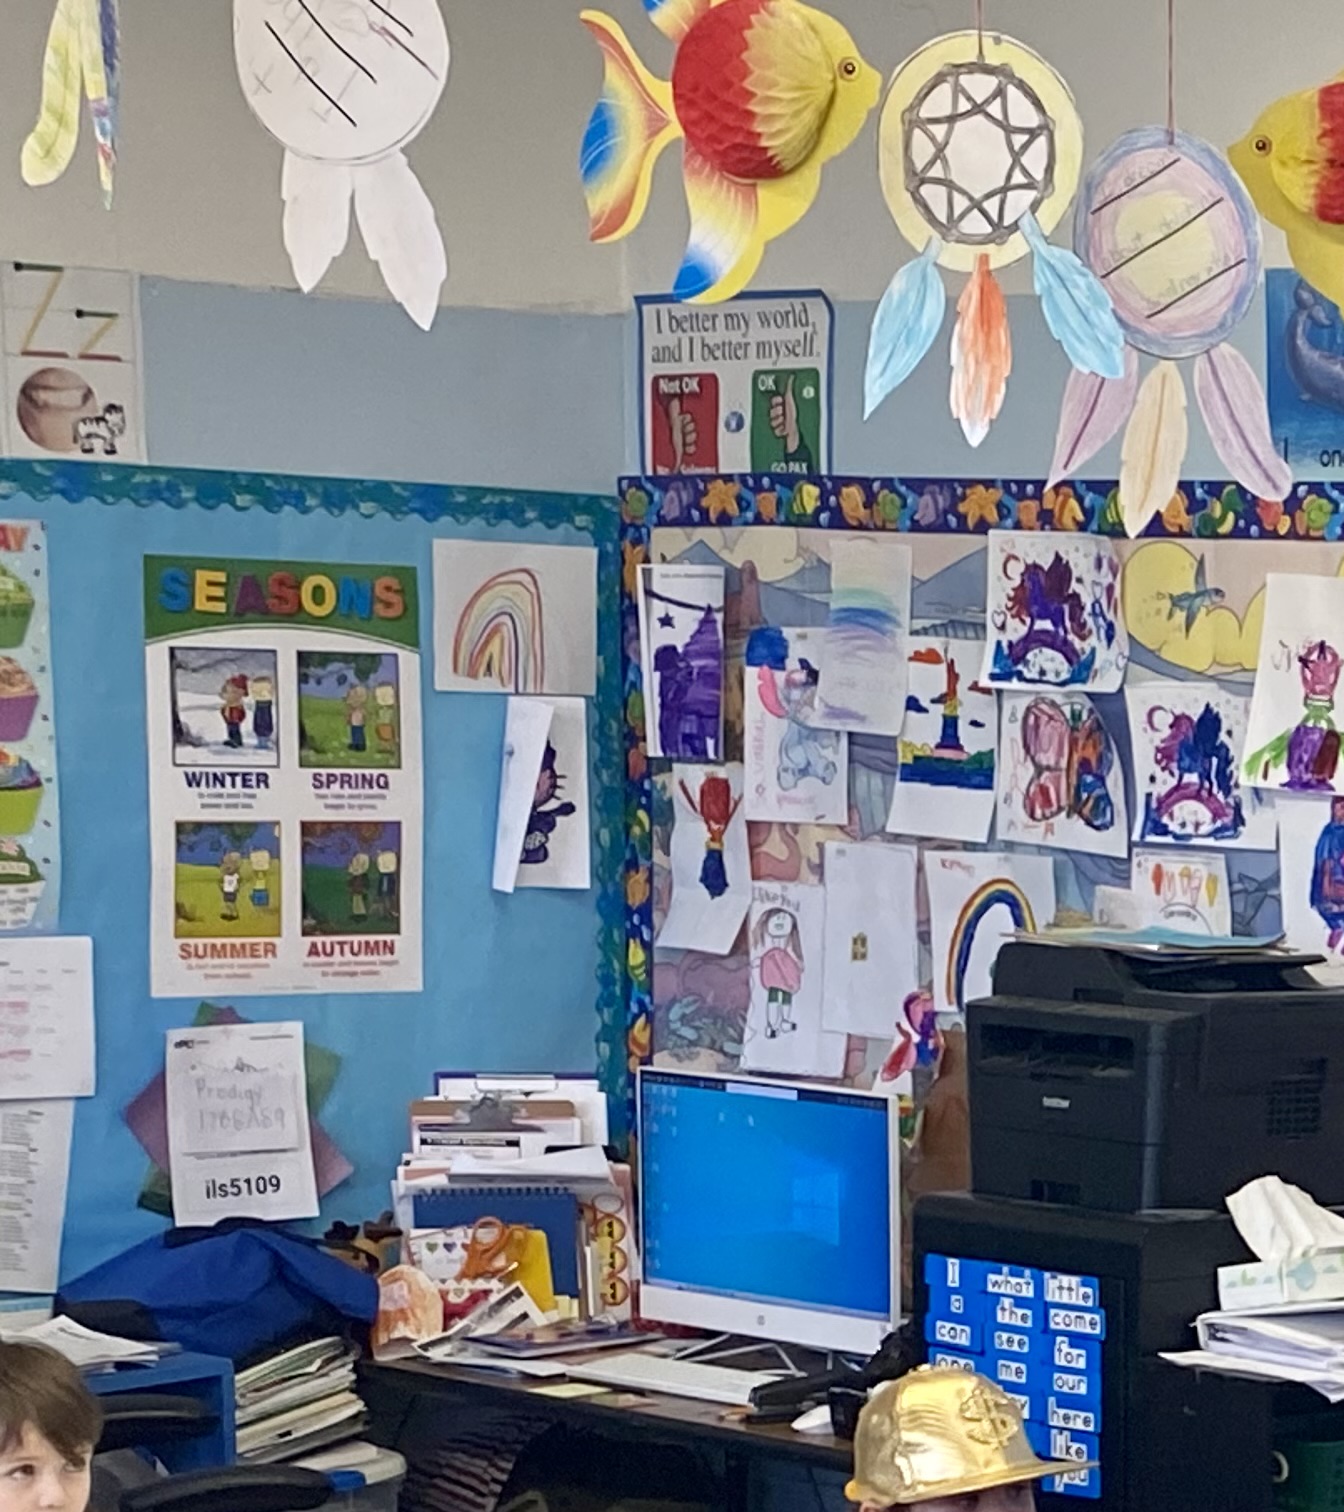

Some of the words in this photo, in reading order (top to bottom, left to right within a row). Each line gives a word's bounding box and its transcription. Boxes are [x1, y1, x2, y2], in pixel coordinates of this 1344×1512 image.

[655, 308, 663, 334] I
[667, 308, 719, 333] better
[723, 312, 751, 338] my
[756, 302, 818, 335] world,
[651, 337, 682, 363] and
[688, 336, 695, 362] I
[700, 337, 751, 361] better
[755, 331, 821, 366] myself.
[657, 378, 681, 395] Not
[681, 376, 700, 393] OK
[757, 374, 777, 391] OK
[158, 567, 405, 621] SEASONS
[183, 770, 270, 789] WINTER
[311, 771, 390, 791] SPRING
[178, 941, 278, 960] SUMMER
[305, 939, 396, 958] AUTUMN
[949, 1261, 958, 1284] I
[989, 1266, 1033, 1294] what
[1047, 1275, 1094, 1305] little
[951, 1297, 963, 1312] a
[998, 1299, 1031, 1325] the
[1051, 1311, 1100, 1331] come
[937, 1325, 969, 1344] can
[995, 1334, 1028, 1351] see
[1056, 1338, 1086, 1366] for
[999, 1362, 1025, 1380] me
[1054, 1376, 1086, 1393] our
[1050, 1399, 1094, 1429] here
[1052, 1432, 1086, 1460] like
